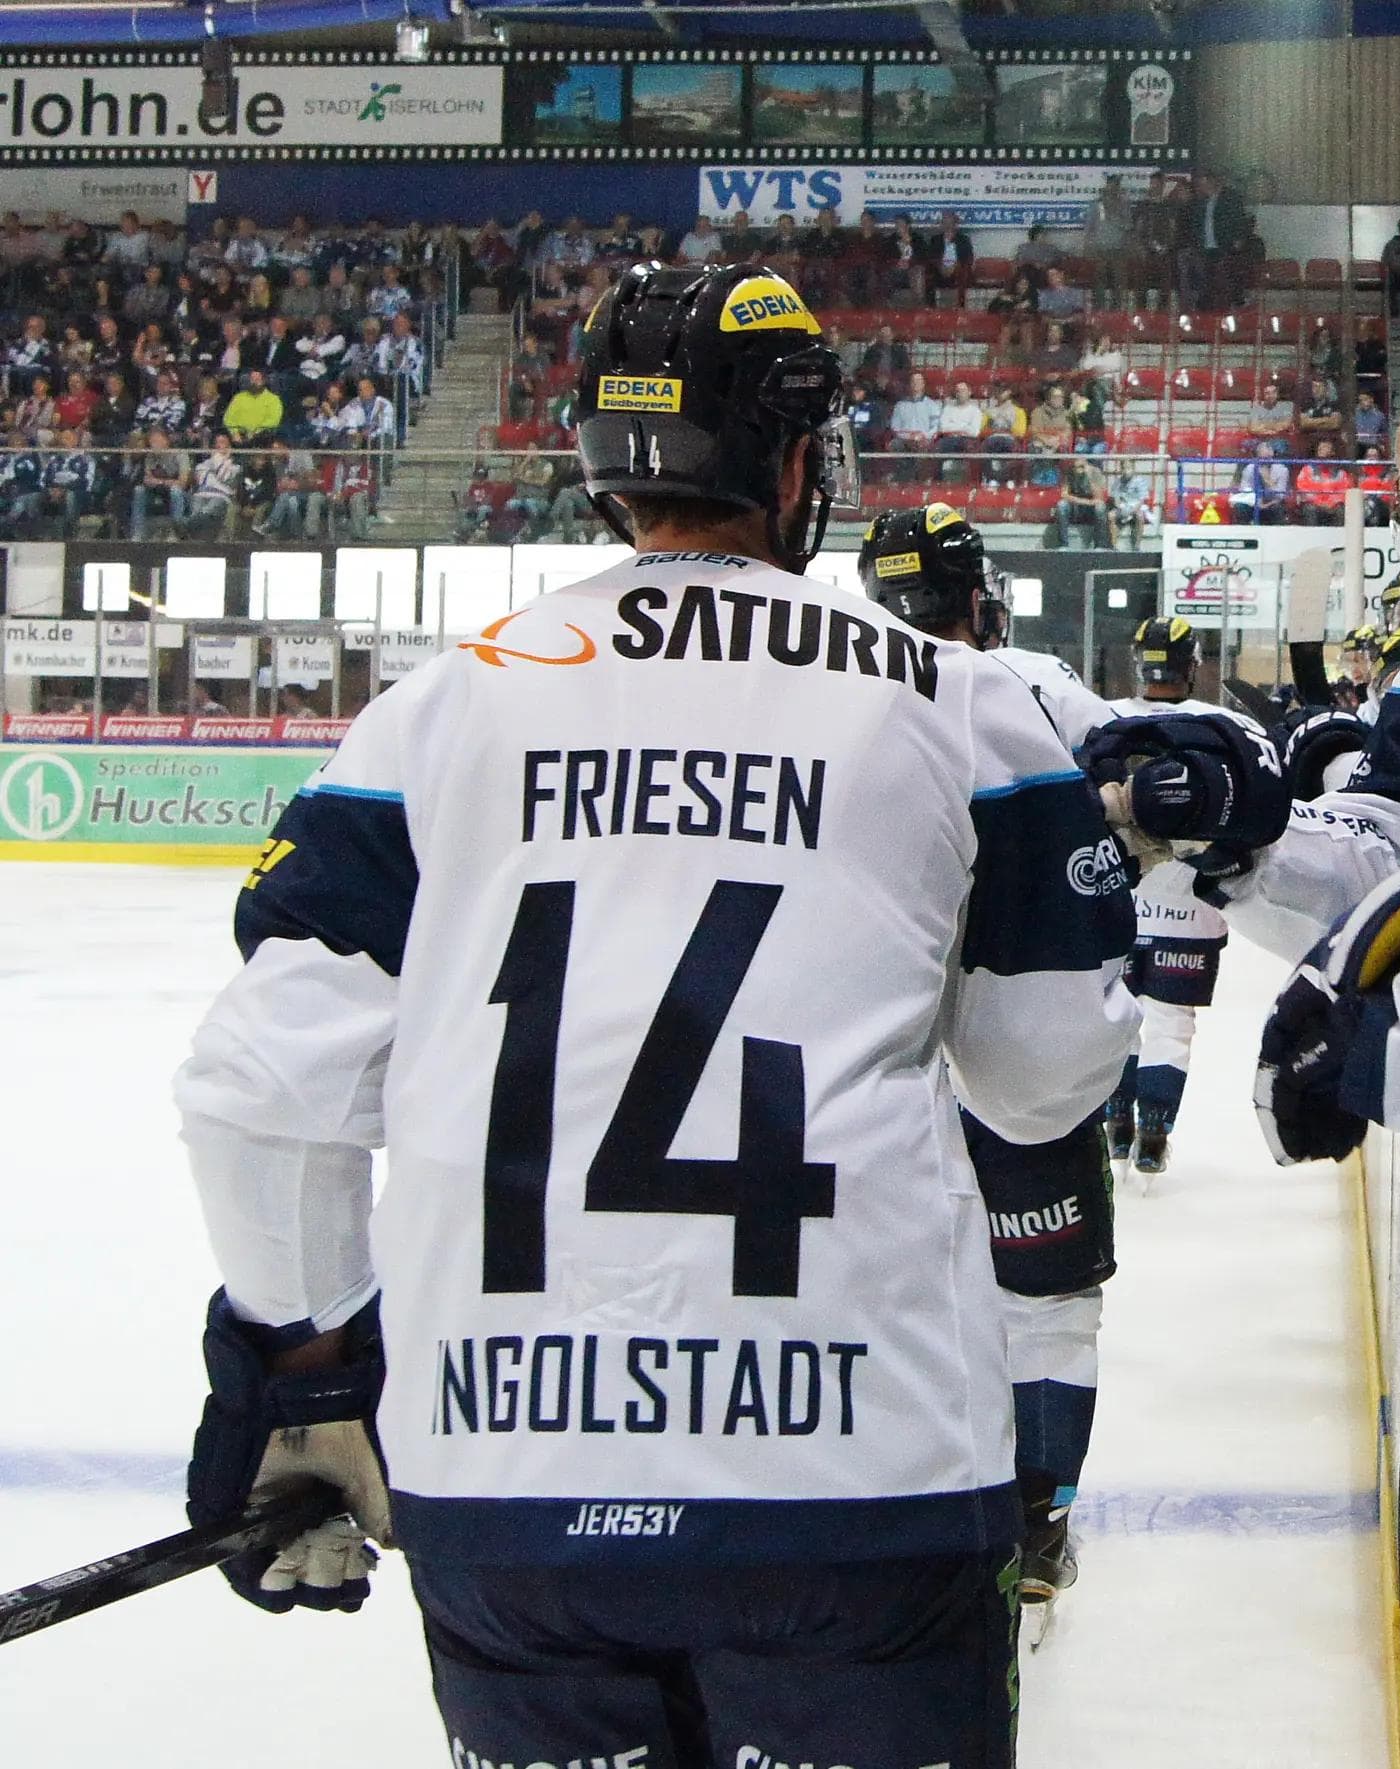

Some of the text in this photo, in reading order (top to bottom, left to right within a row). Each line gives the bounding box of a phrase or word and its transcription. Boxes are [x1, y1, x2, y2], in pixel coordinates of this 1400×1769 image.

[303, 99, 485, 115] STADT ISERLOHN
[193, 173, 215, 200] Y
[706, 169, 843, 211] WTS
[729, 293, 800, 326] EDEKA
[603, 379, 675, 398] EDEKA
[7, 623, 73, 642] mk.de
[612, 585, 938, 702] SATURN
[8, 721, 88, 737] WINNER
[103, 722, 182, 738] WINNER
[191, 725, 271, 739] WINNER
[283, 726, 349, 740] WINNE
[97, 757, 220, 781] Spedition
[521, 748, 827, 851] FRIESEN
[1154, 950, 1206, 971] CINQUE
[482, 878, 837, 1299] 14
[432, 1334, 869, 1437] NGOLSTADT
